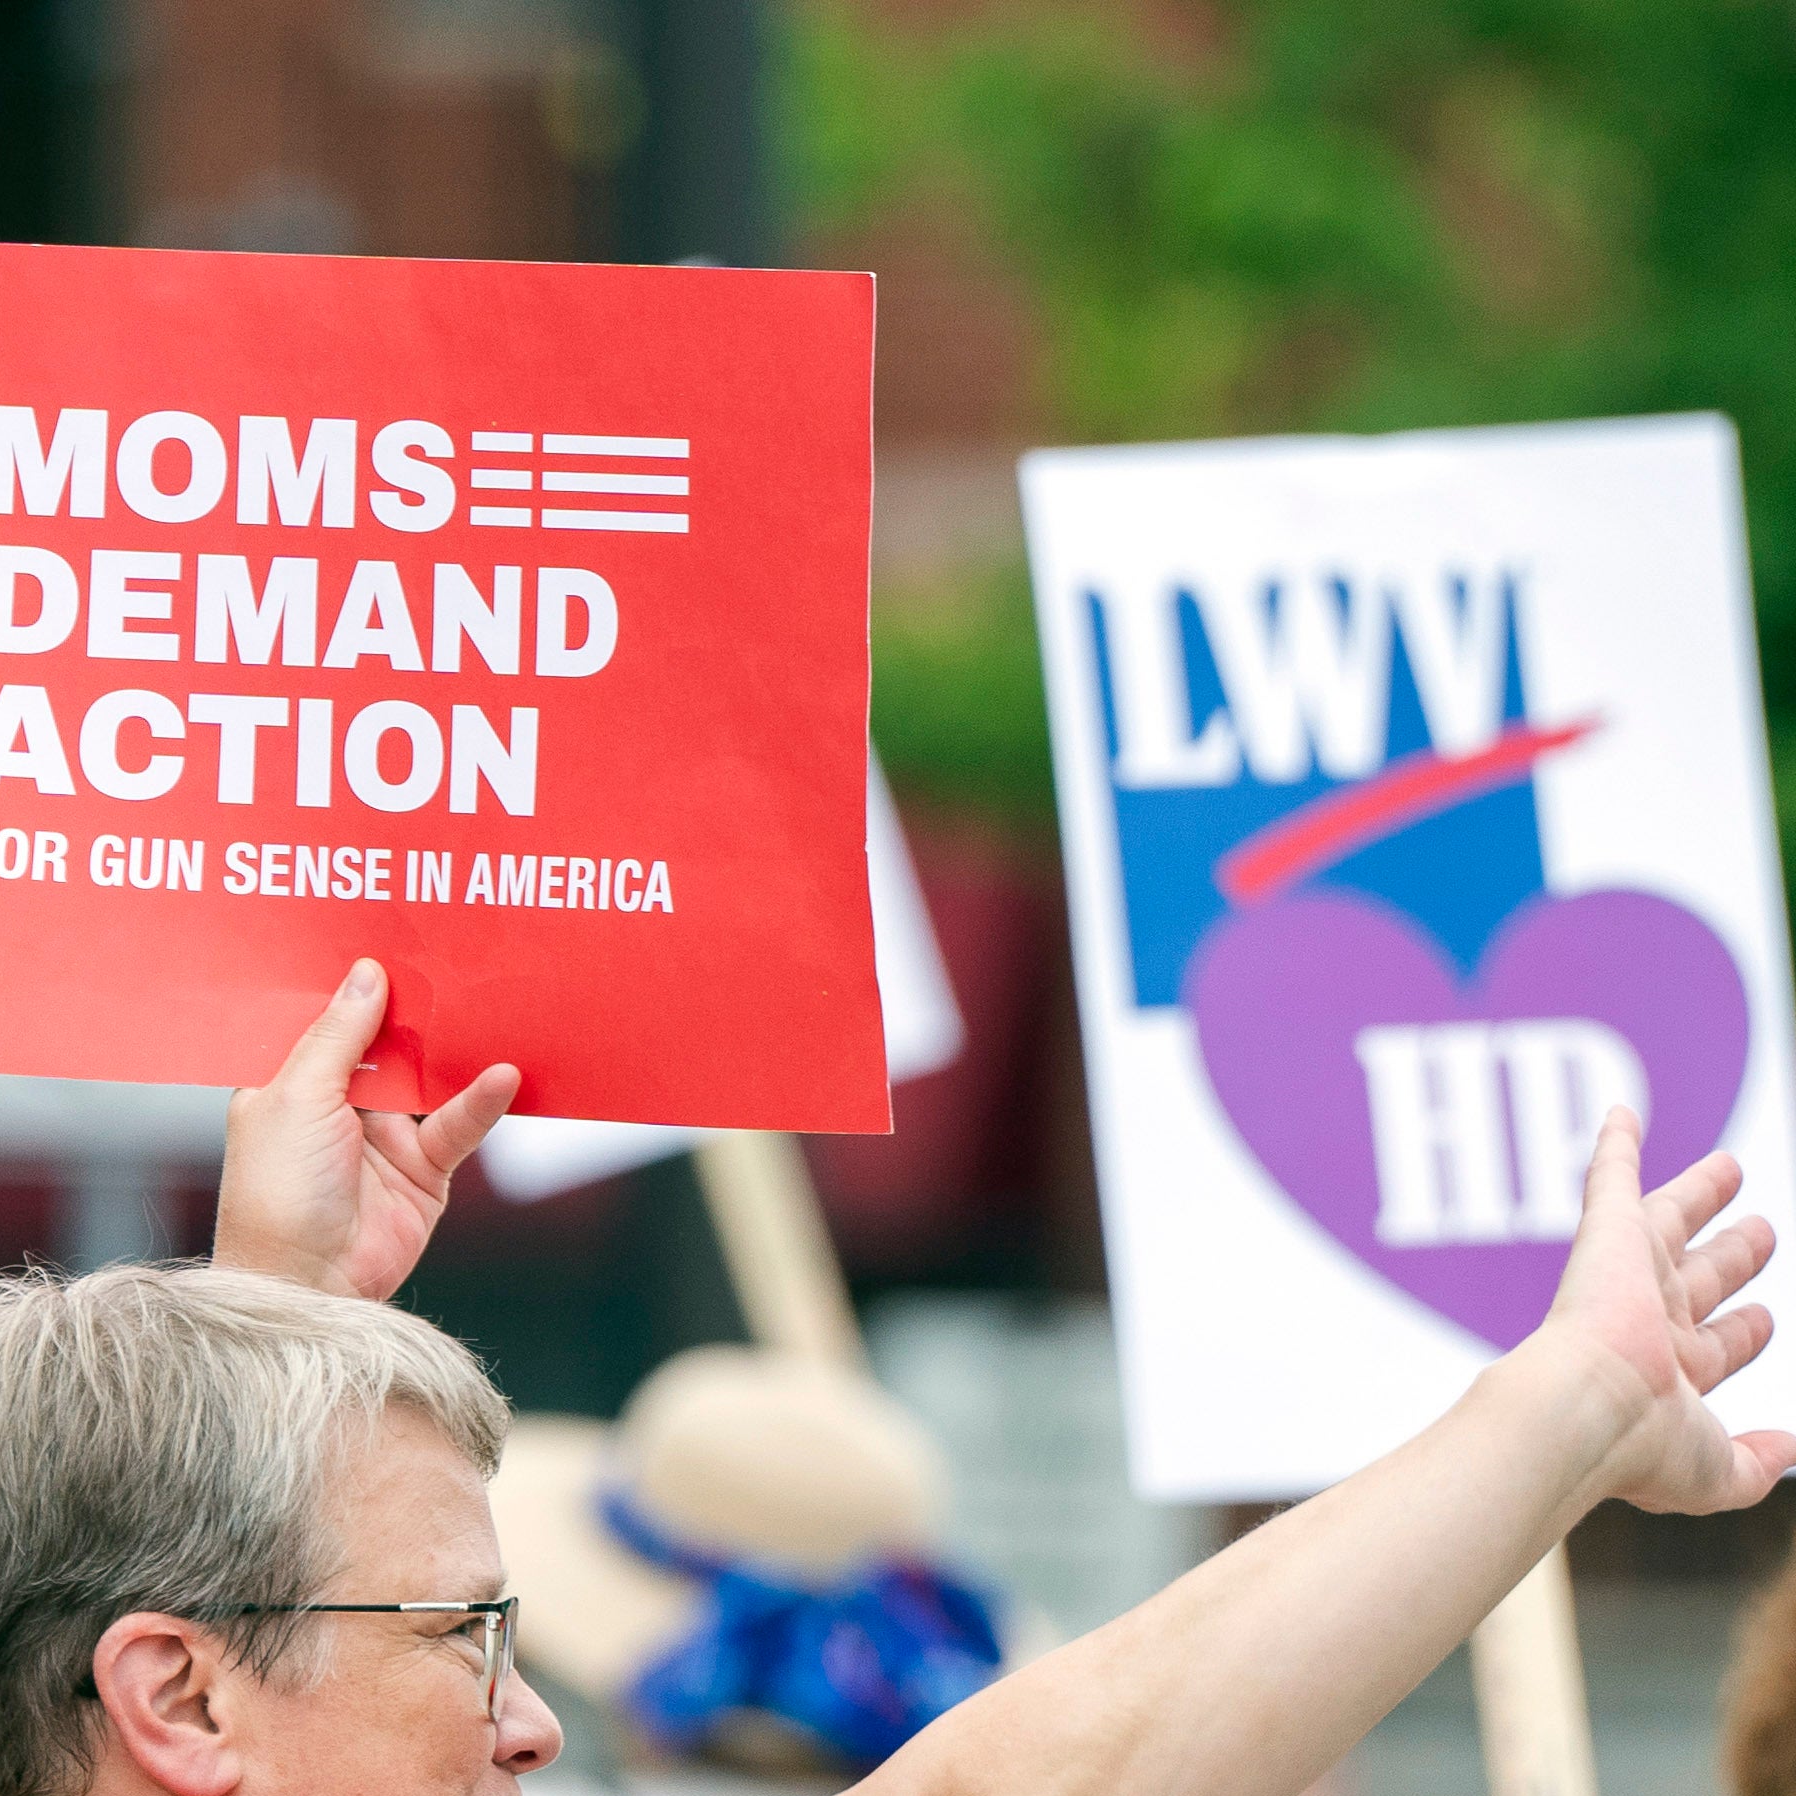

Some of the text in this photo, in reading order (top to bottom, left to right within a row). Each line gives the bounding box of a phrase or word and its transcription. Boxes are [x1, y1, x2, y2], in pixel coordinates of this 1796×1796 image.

[1089, 568, 1522, 790] LWV
[89, 833, 206, 892] GUN
[222, 841, 392, 902] SENSE
[405, 850, 453, 904] IN
[464, 852, 674, 914] AMERICA
[1356, 1018, 1650, 1248] HP
